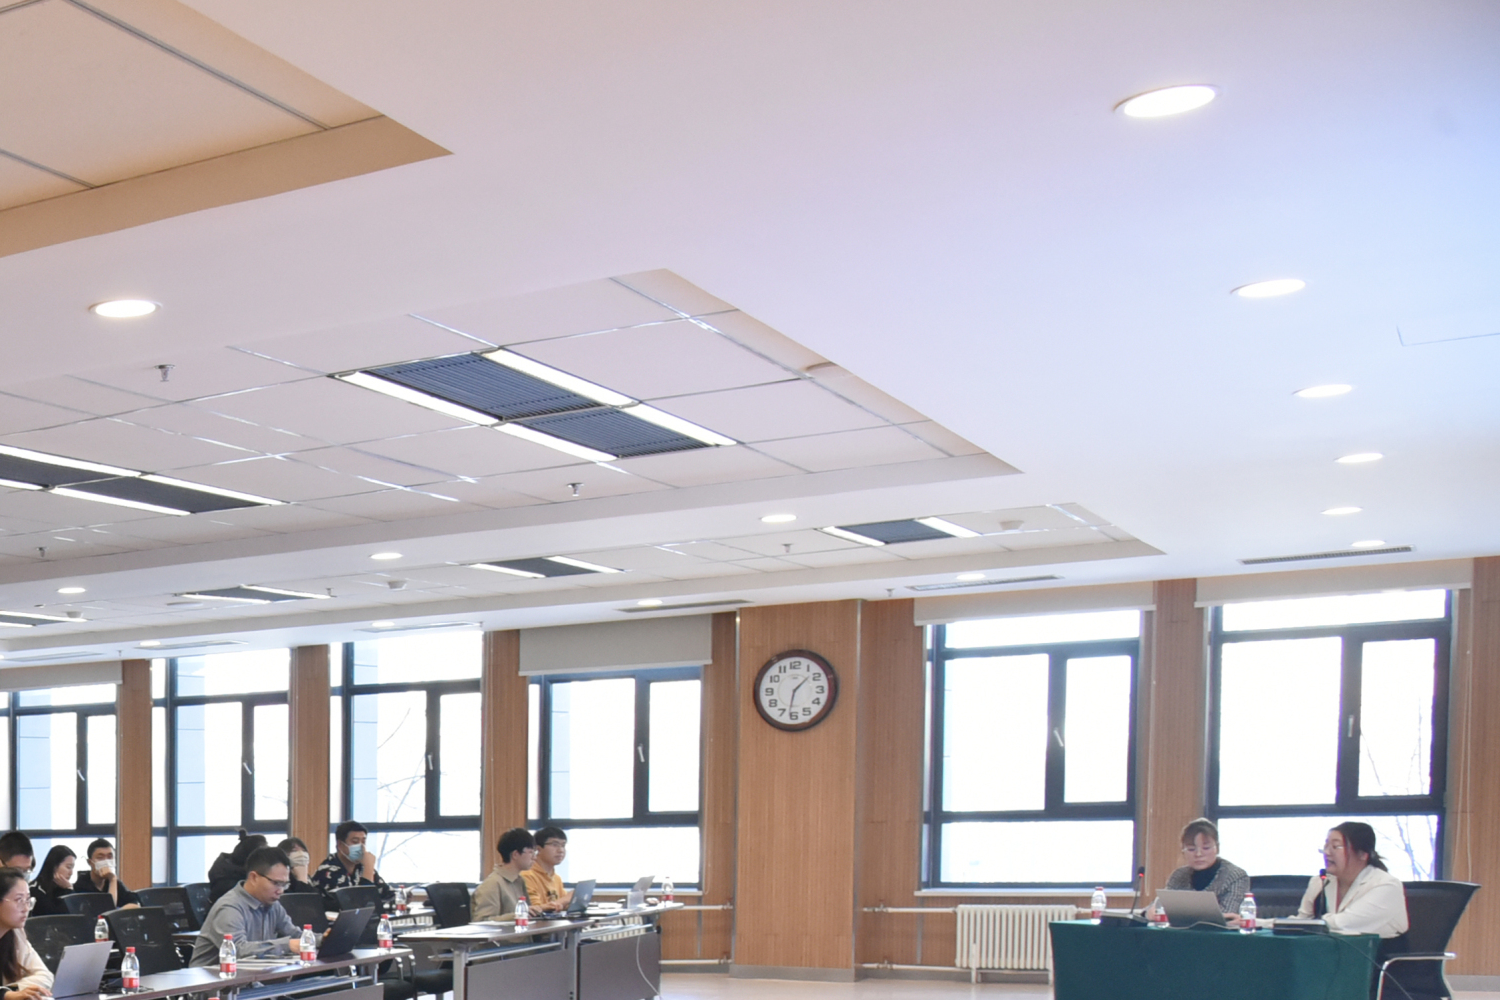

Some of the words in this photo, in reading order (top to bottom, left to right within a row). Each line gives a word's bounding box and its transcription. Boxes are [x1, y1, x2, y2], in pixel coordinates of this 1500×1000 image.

[778, 665, 787, 674] 11
[789, 660, 802, 670] 12
[769, 674, 780, 683] 10
[812, 672, 822, 681] 2
[765, 687, 774, 696] 9
[815, 685, 825, 694] 3
[768, 699, 778, 708] 8
[812, 697, 821, 706] 4
[777, 708, 787, 717] 7
[789, 711, 799, 721] 6
[802, 707, 812, 716] 5
